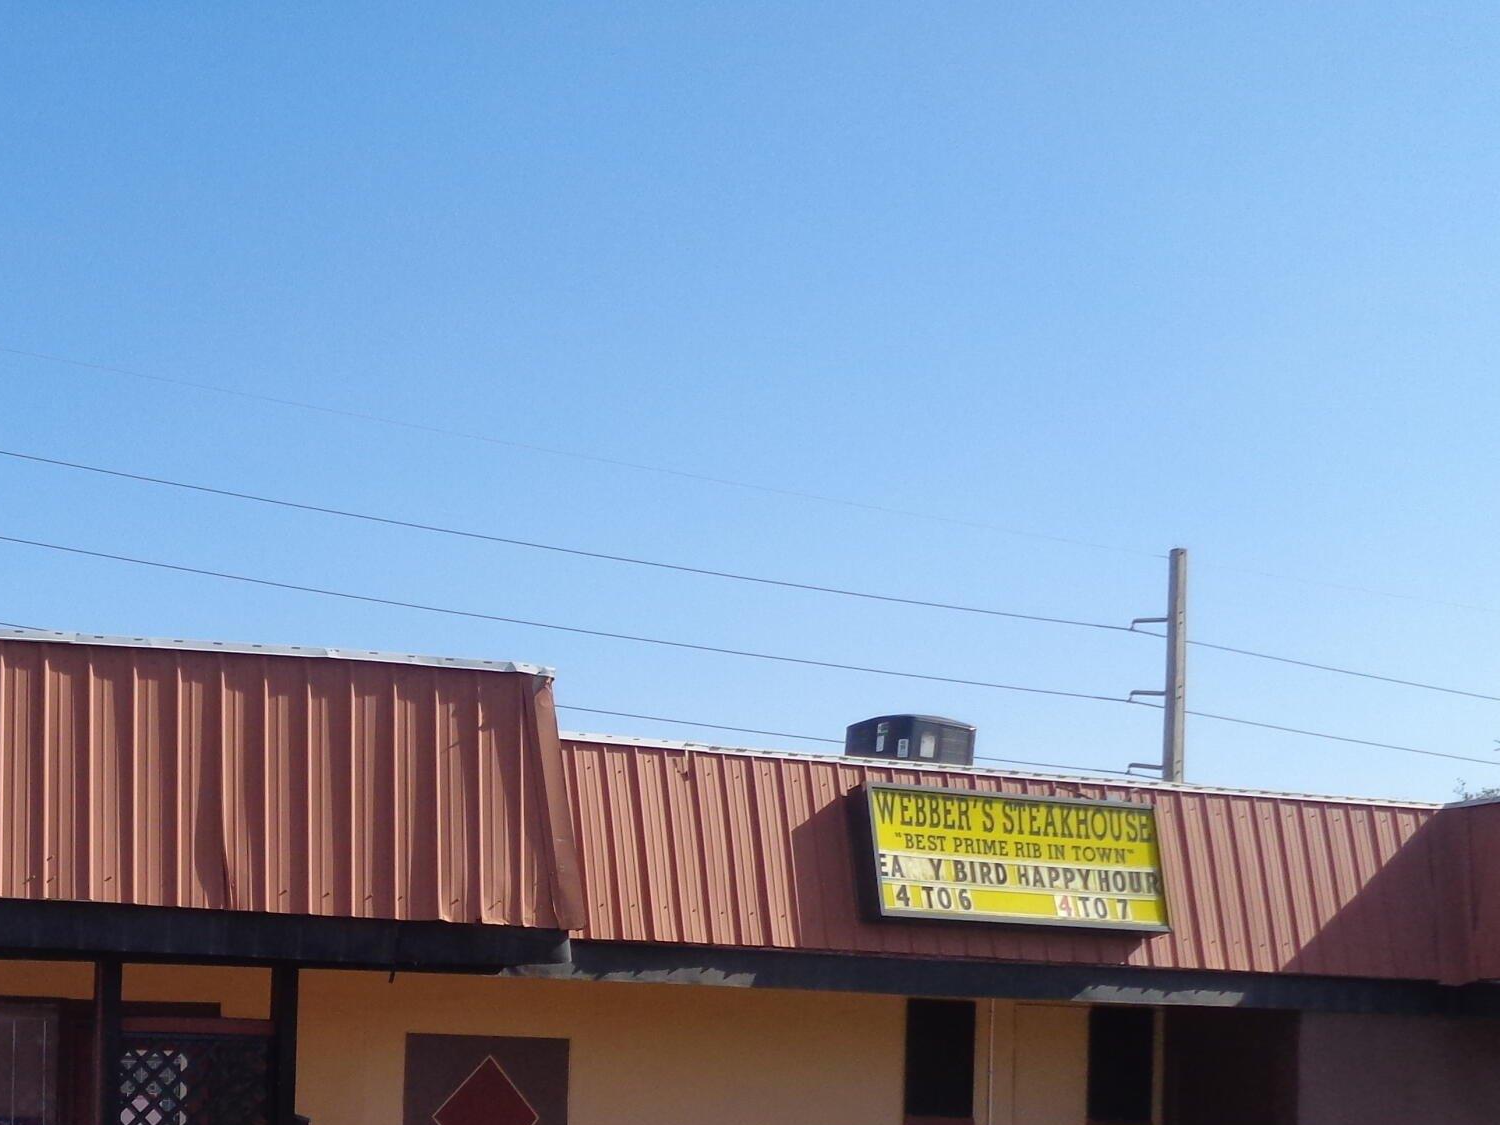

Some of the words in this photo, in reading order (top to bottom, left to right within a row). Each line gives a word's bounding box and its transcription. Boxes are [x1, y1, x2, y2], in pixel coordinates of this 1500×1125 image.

[875, 791, 995, 833] WEBBER'S
[1002, 801, 1152, 843] STEAKHOUSE
[952, 837, 1009, 857] PRIME
[1014, 842, 1042, 859] RIB
[1047, 844, 1066, 861] IN
[953, 859, 1008, 885] BIRD
[1016, 865, 1091, 891] HAPPY
[1097, 870, 1162, 895] HOUR
[895, 884, 910, 907] 4
[921, 886, 952, 910] TO
[958, 889, 972, 911] 6
[1058, 895, 1072, 917] 4
[1078, 896, 1108, 919] TO
[1116, 898, 1128, 920] 7
